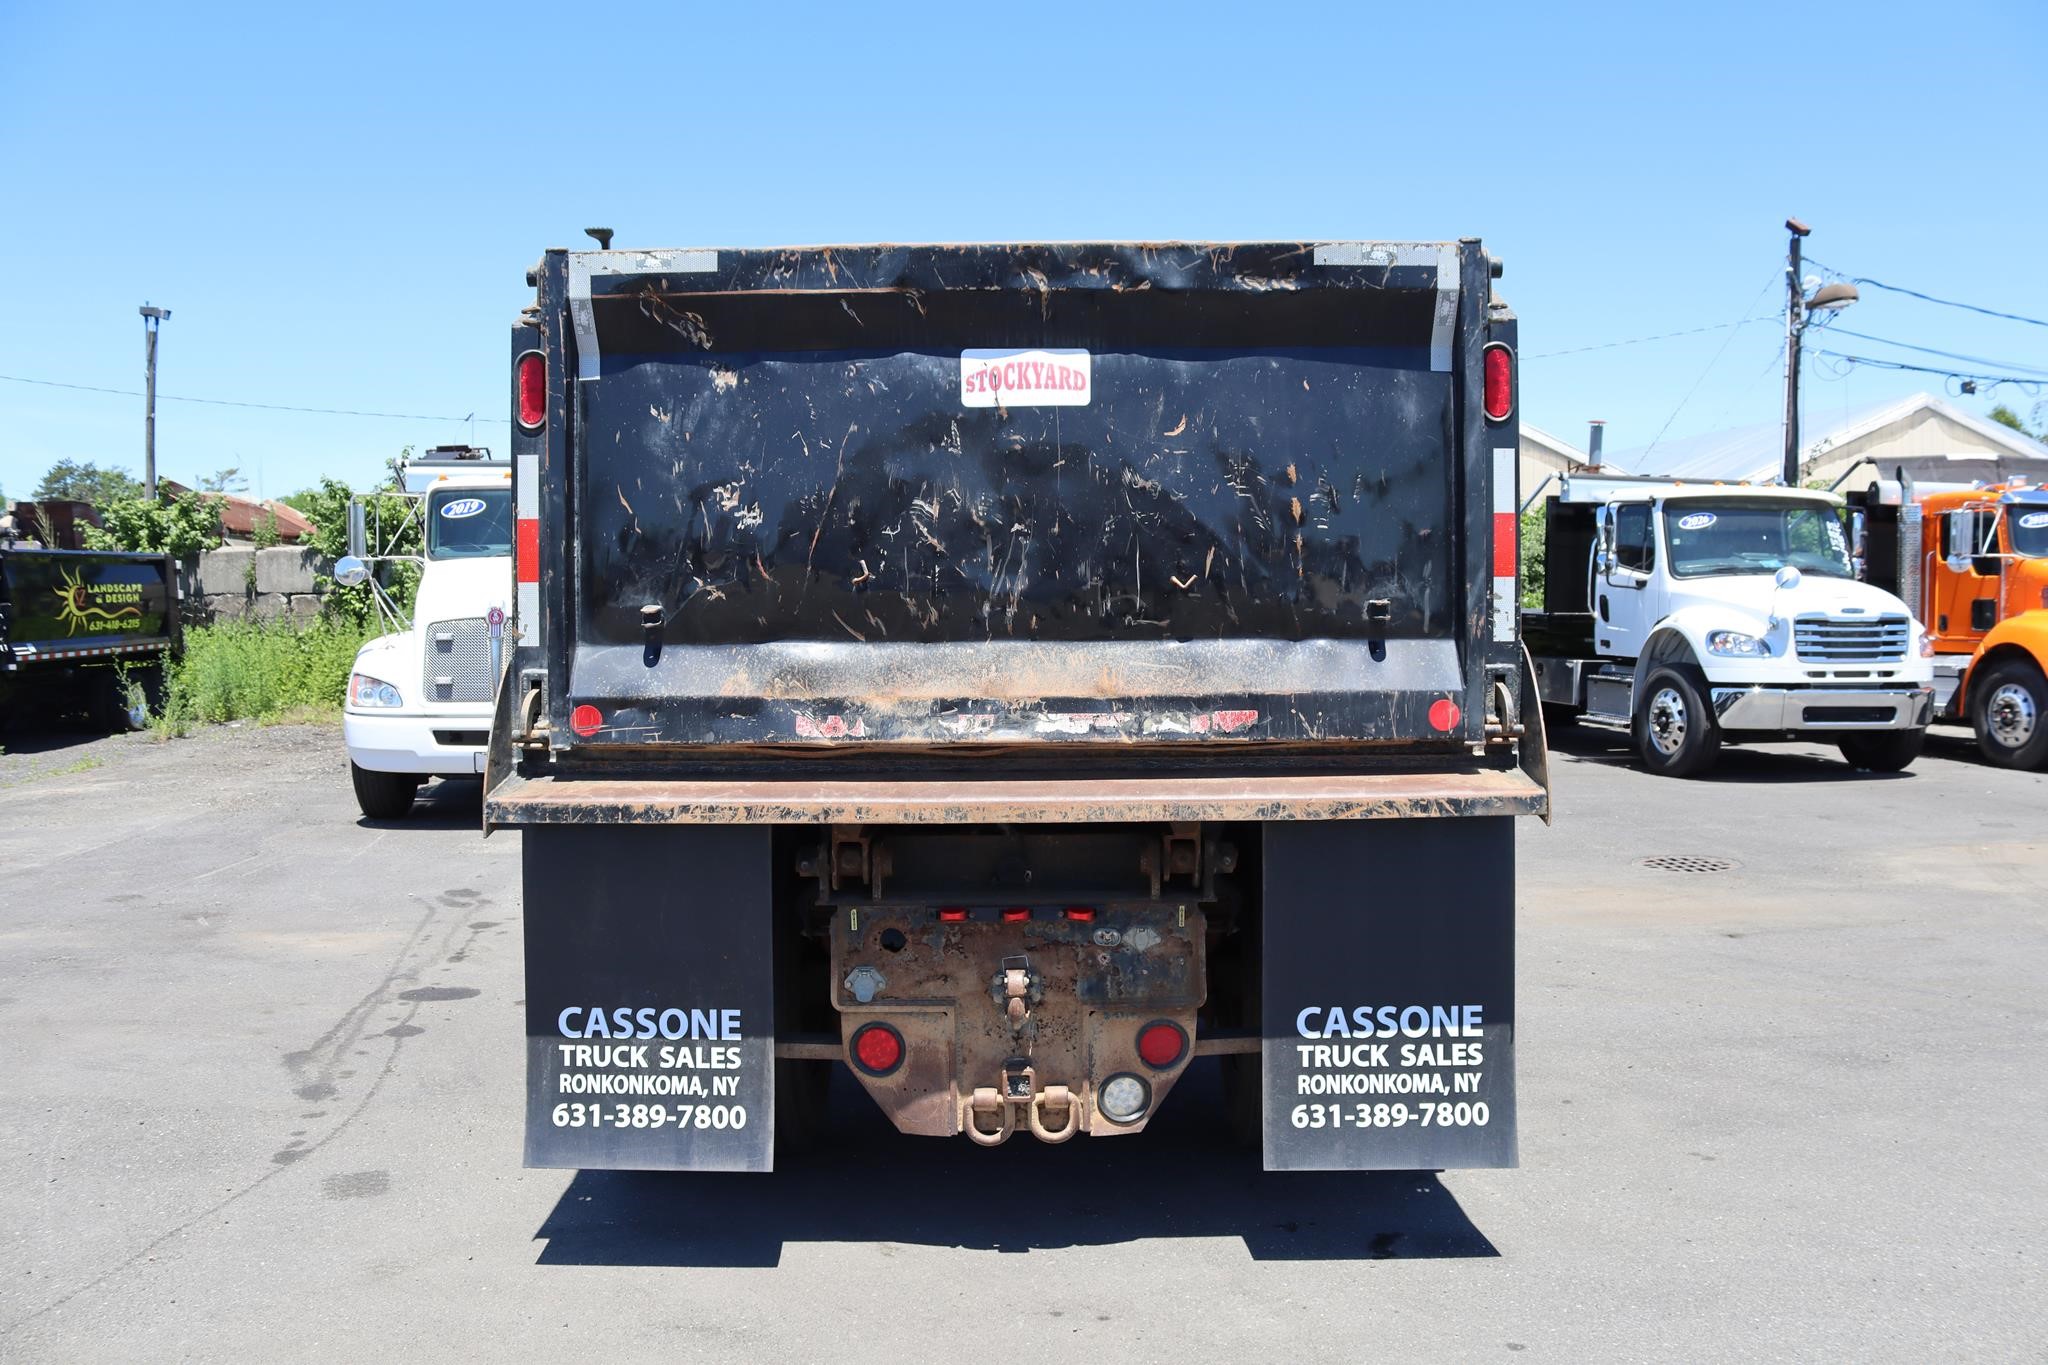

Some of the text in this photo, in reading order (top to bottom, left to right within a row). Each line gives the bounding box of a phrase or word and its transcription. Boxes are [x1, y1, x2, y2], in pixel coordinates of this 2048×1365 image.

[965, 360, 1086, 393] STOCKYARD
[448, 501, 479, 516] 2019
[87, 583, 143, 593] LANDSCAPE
[105, 593, 140, 603] DESIGN
[558, 1006, 742, 1041] CASSONE
[1296, 1005, 1484, 1039] CASSONE
[558, 1044, 742, 1069] TRUCK SALES
[1296, 1043, 1484, 1068] TRUCK SALES
[559, 1073, 740, 1099] RONKONKOMA, NY
[1297, 1072, 1482, 1097] RONKONKOMA, NY
[552, 1103, 747, 1130] 631-389-7800
[1291, 1102, 1490, 1129] 631-389-7800
